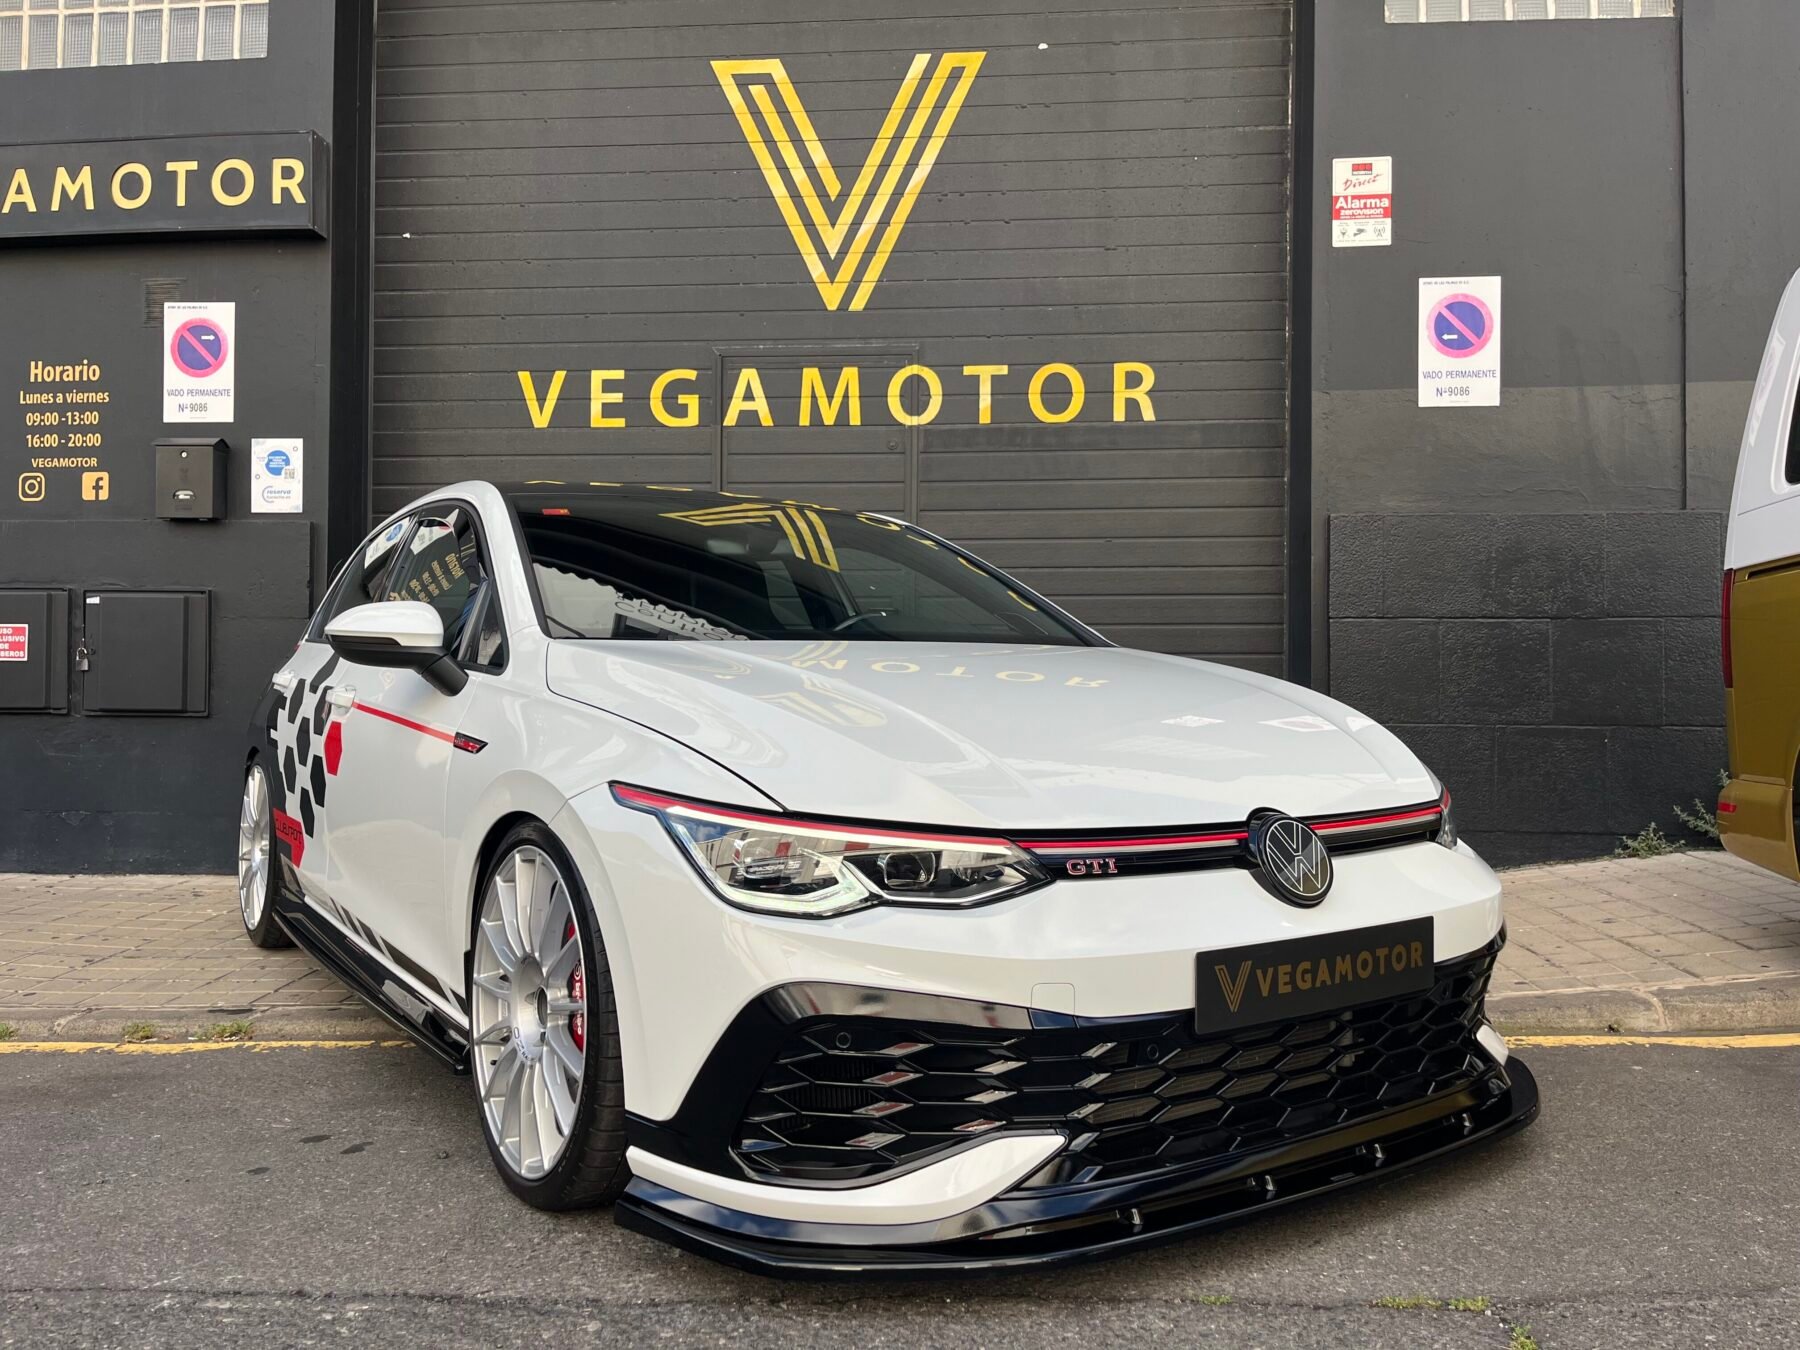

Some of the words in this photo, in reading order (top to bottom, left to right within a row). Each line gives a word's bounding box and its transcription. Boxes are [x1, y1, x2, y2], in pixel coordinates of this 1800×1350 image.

[1, 157, 307, 214] AMOTOR
[1335, 195, 1389, 209] Alarma
[30, 359, 100, 382] Horario
[1423, 371, 1443, 380] VADO
[1446, 369, 1497, 379] PERMANENTE
[20, 390, 54, 404] Lunes
[56, 393, 63, 403] a
[66, 389, 110, 403] viernes
[167, 389, 184, 397] VADO
[187, 388, 231, 397] PERMANENTE
[517, 362, 1156, 429] VEGAMOTOR
[26, 412, 59, 426] 09:00
[26, 434, 58, 447] 16:00
[68, 433, 101, 447] 20:00
[31, 457, 98, 468] VEGAMOTOR
[1066, 857, 1118, 876] GTI
[1255, 941, 1424, 998] VEGAMOTOR
